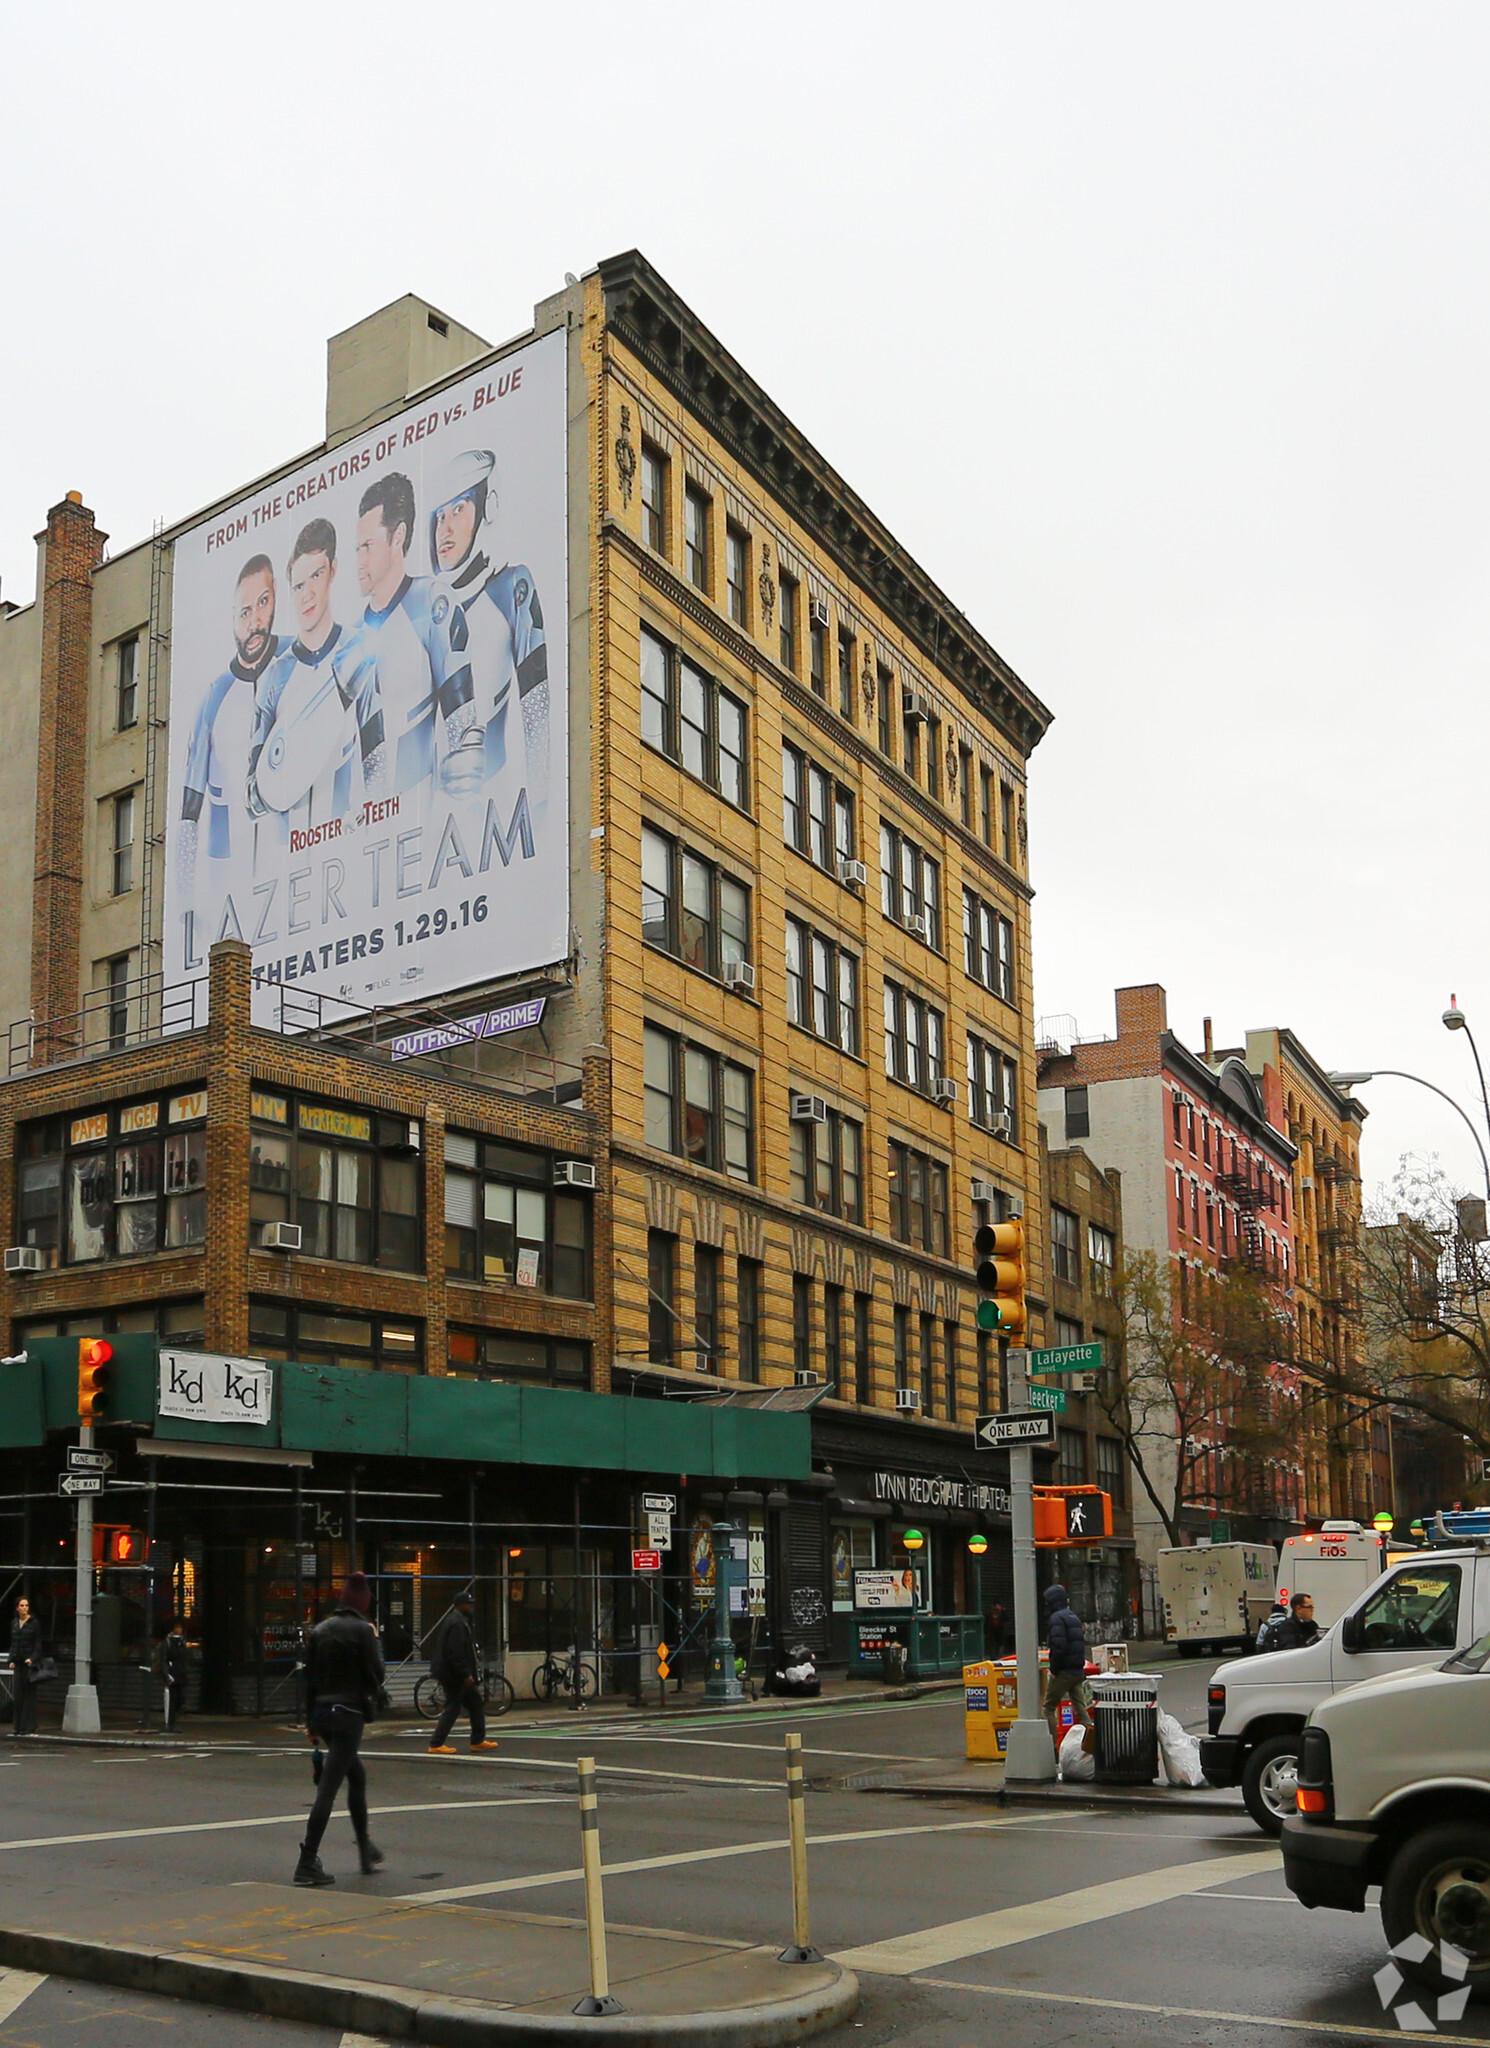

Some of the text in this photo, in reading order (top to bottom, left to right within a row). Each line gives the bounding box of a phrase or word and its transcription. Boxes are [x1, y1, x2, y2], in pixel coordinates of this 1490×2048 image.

[206, 514, 248, 554] FROM
[252, 495, 282, 529] THE
[286, 448, 371, 510] CREATORS
[376, 433, 398, 462] OF
[403, 412, 439, 449] RED
[473, 365, 524, 412] BLUE
[290, 795, 400, 854] ROOSTER TEETH
[184, 786, 536, 971] LAZER TEAM
[252, 894, 489, 991] THEATERS 1.29.16
[394, 1004, 538, 1055] OUTFRONT PRIME
[72, 1094, 202, 1144] PAPER TIGER TV
[1037, 1347, 1092, 1366] Lafayette
[169, 1357, 203, 1404] kd
[224, 1363, 258, 1409] kd
[1029, 1386, 1059, 1410] leecker
[989, 1421, 1043, 1438] ONE WAY
[74, 1454, 90, 1464] ONE
[66, 1480, 98, 1490] ONE WAY
[874, 1472, 906, 1500] LYNN
[909, 1476, 965, 1508] REDGRAVE
[966, 1484, 1007, 1511] THEATER
[651, 1525, 669, 1534] TRAFFIC
[654, 1516, 664, 1525] ALL
[1320, 1546, 1347, 1557] FiOS
[859, 1625, 897, 1633] Bleecker St
